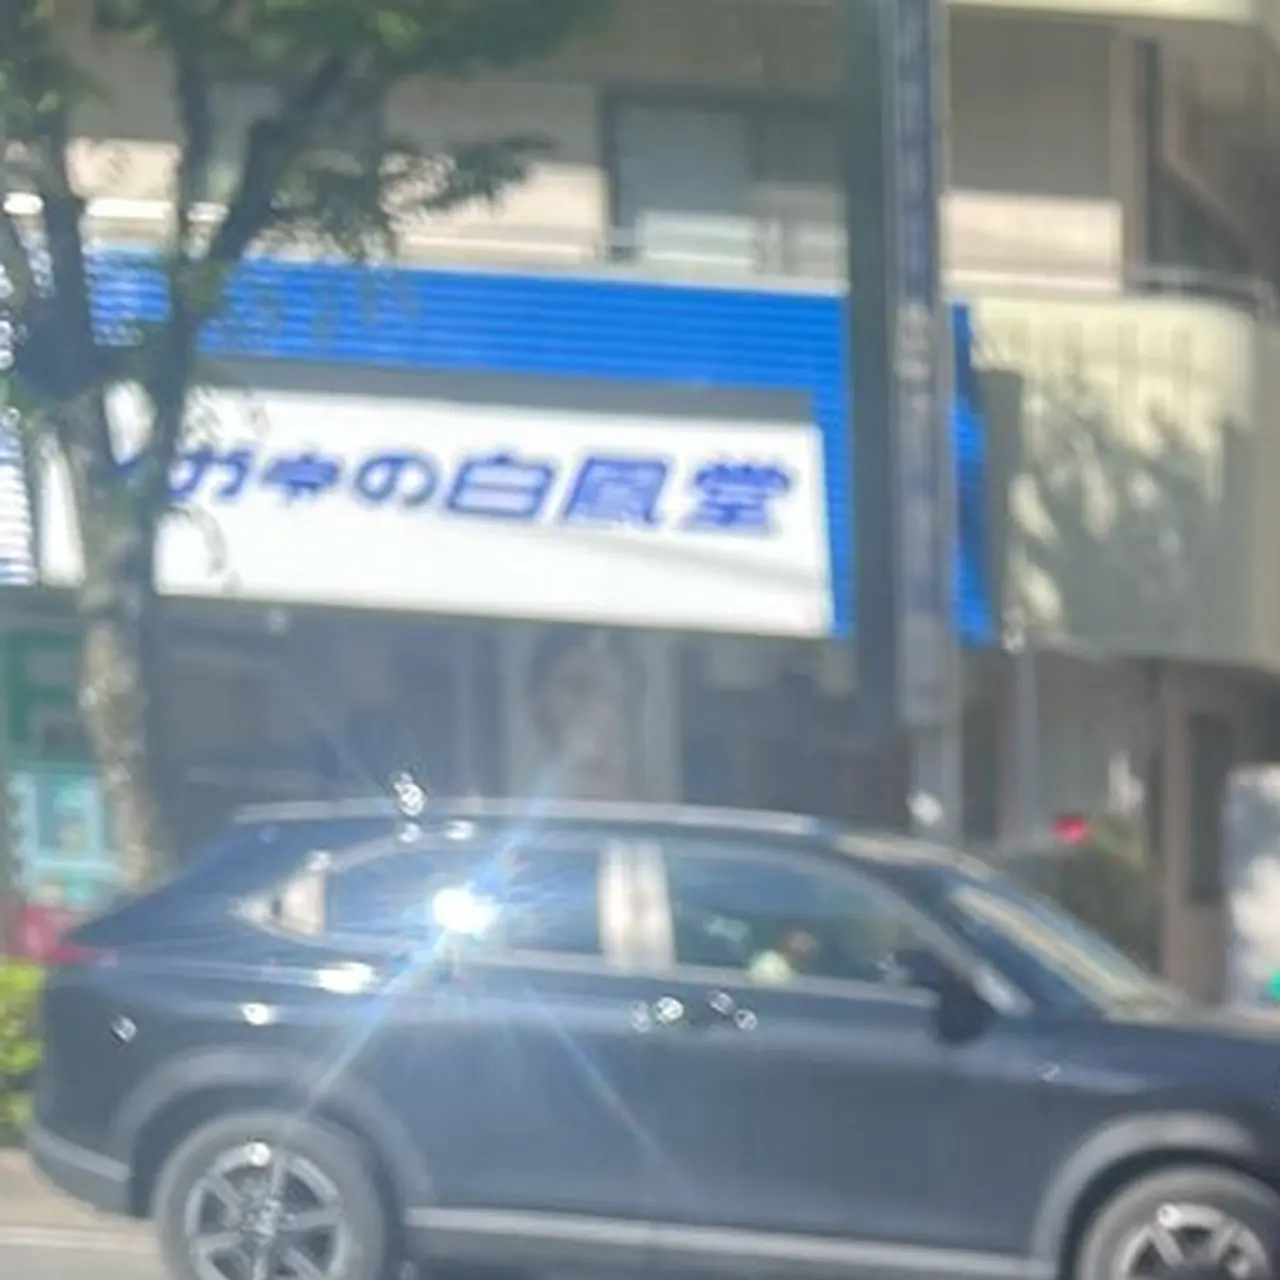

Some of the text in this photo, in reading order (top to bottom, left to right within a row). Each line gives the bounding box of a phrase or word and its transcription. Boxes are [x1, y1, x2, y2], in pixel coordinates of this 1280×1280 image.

[112, 440, 792, 538] ガネの白鳳堂
